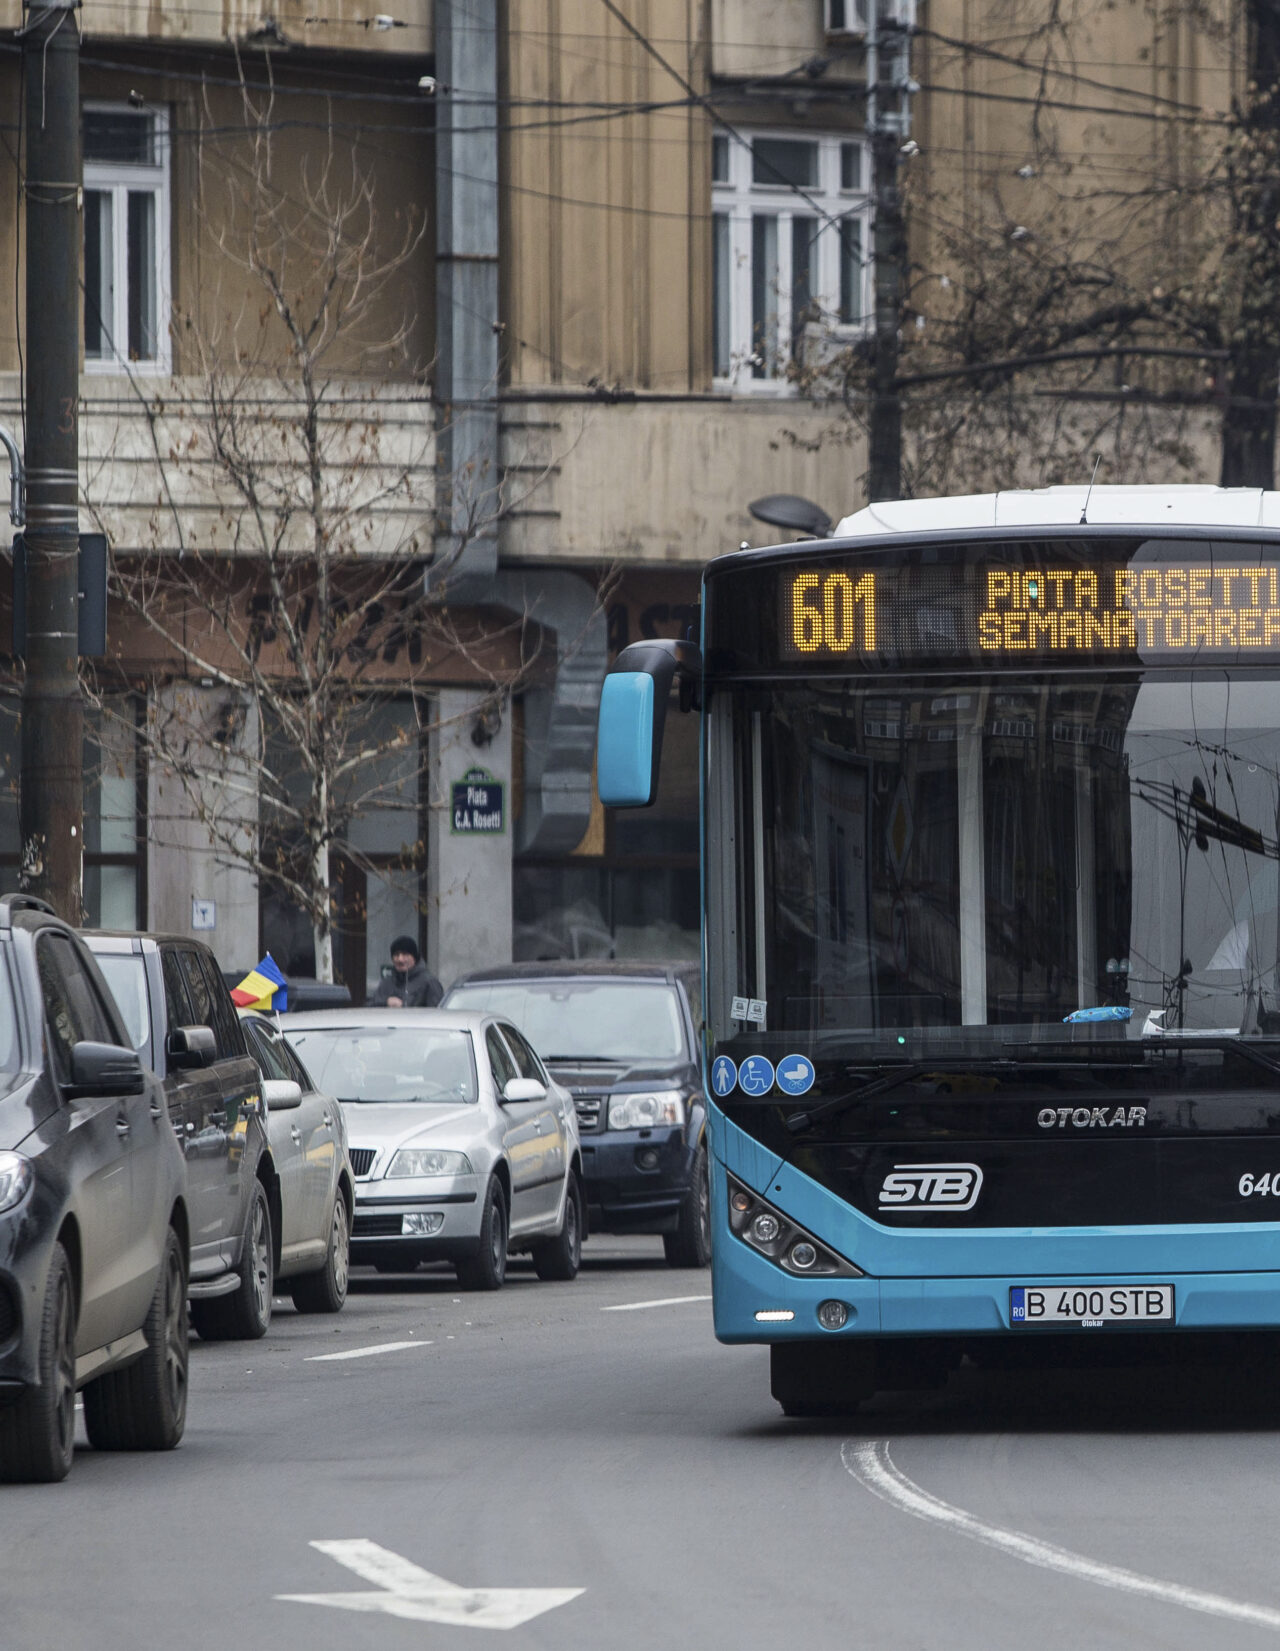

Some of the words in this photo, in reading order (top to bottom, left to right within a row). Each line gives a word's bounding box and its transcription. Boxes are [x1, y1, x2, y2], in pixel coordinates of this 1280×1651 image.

[988, 571, 1098, 609] PIATA
[1115, 567, 1279, 608] ROSETTI
[793, 573, 875, 651] 601
[473, 809, 500, 829] Rosetti
[1037, 1107, 1148, 1128] OTOKAR
[878, 1171, 974, 1203] STB
[1012, 1306, 1025, 1317] RO
[1027, 1292, 1046, 1317] B
[1056, 1291, 1104, 1316] 400
[1109, 1290, 1165, 1316] STB
[1081, 1319, 1104, 1328] Otokar
